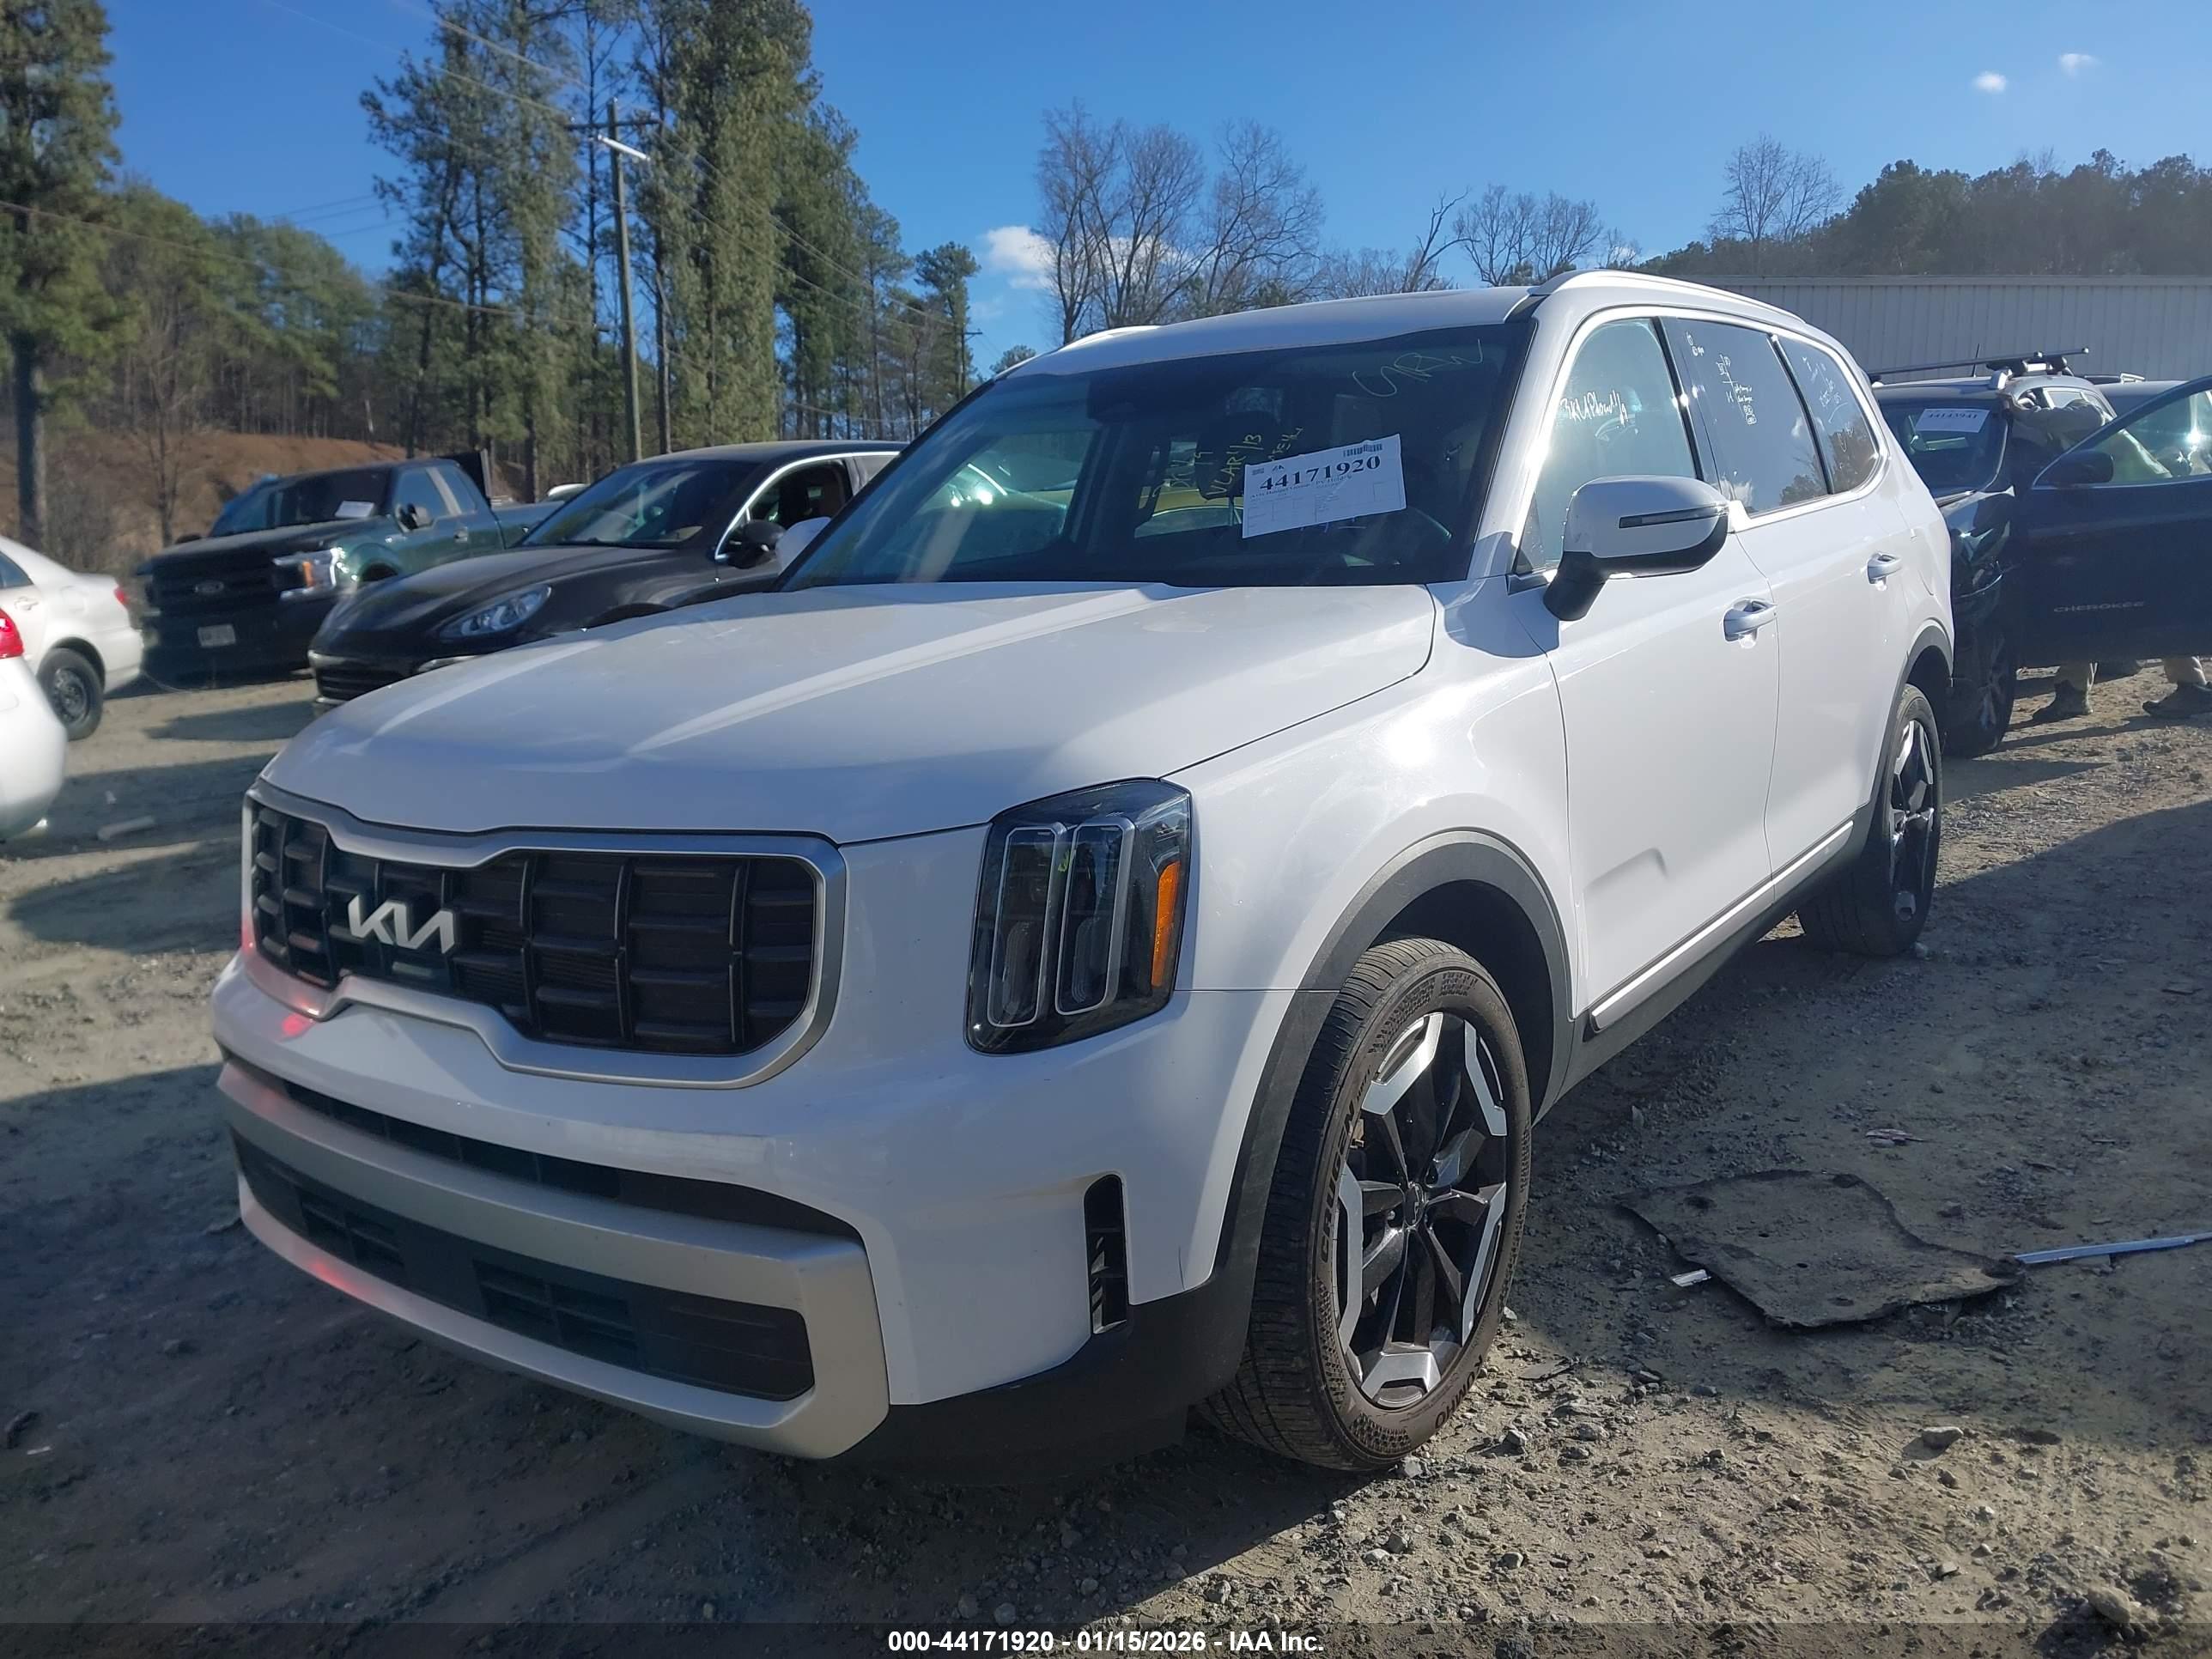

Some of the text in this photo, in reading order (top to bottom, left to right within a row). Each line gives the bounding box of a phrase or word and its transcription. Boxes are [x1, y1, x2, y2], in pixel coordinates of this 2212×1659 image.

[1260, 455, 1381, 490] 44171920
[2054, 601, 2144, 612] CHEROKEE
[348, 895, 454, 954] KIA
[1321, 1099, 1354, 1263] CRUGEN
[1435, 1353, 1484, 1430] KUMHO
